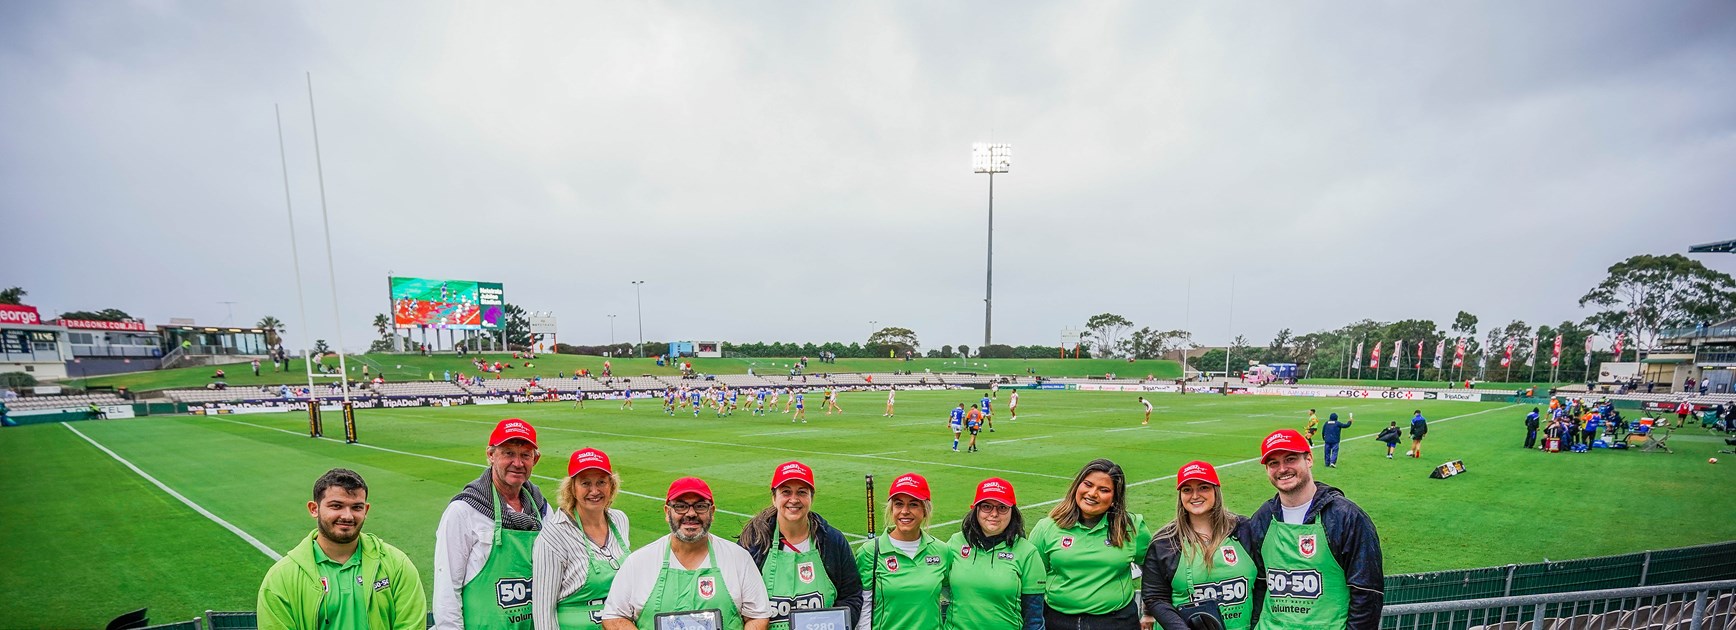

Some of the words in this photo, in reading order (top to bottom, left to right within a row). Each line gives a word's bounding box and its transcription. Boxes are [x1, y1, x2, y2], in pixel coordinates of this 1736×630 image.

[0, 310, 36, 324] eorge
[1382, 391, 1403, 399] CBC
[381, 399, 420, 408] TripADeal
[1268, 574, 1318, 593] 50-50
[501, 583, 532, 602] 50-
[1193, 582, 1245, 601] 50-50
[508, 613, 532, 624] Volun
